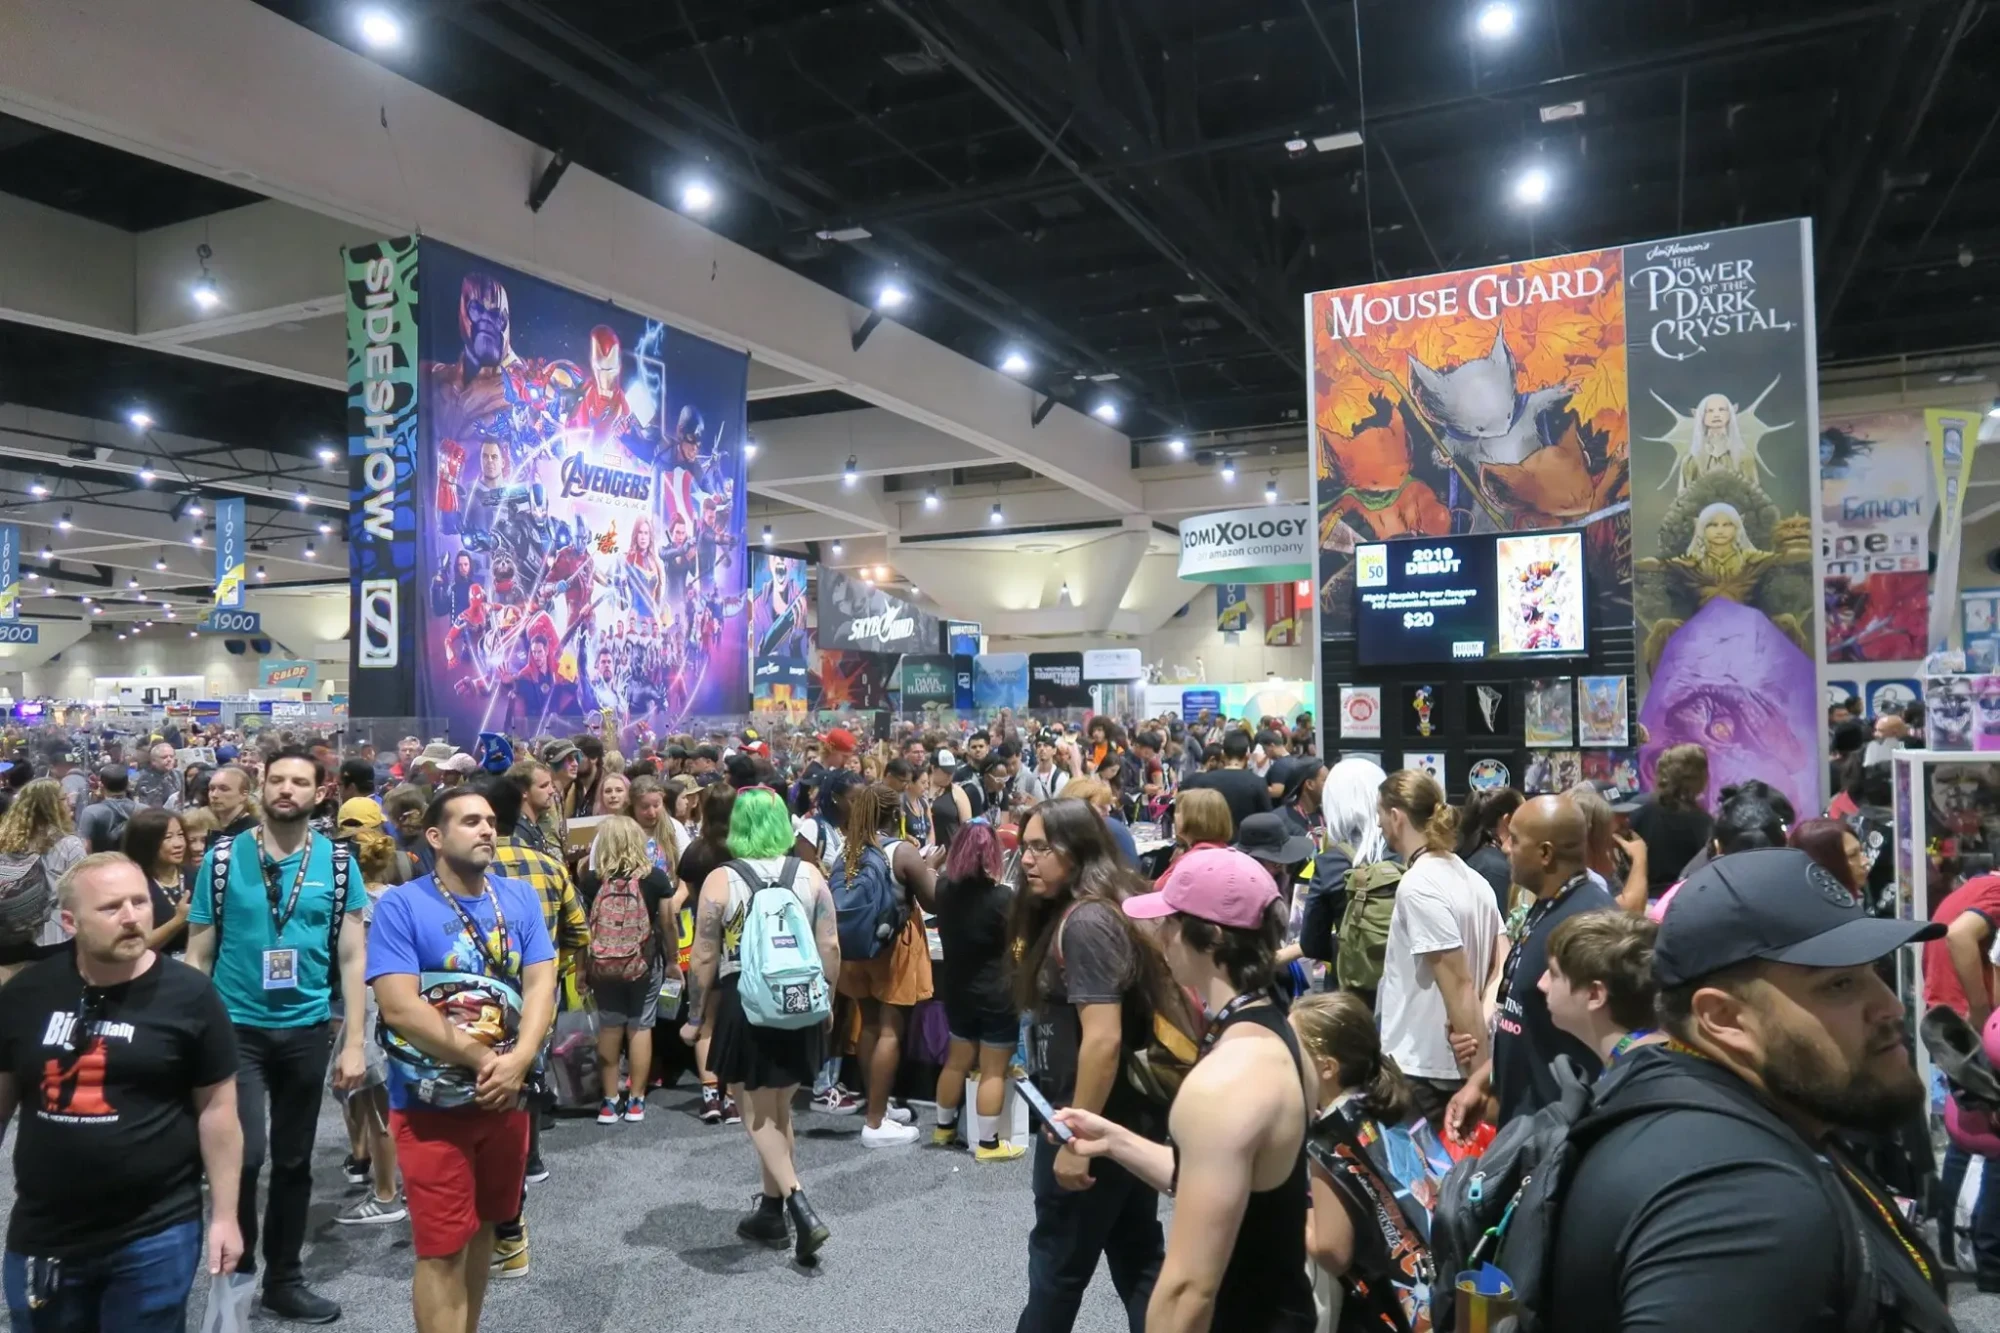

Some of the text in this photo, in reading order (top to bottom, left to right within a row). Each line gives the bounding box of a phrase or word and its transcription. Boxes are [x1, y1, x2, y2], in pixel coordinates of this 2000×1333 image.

[1669, 256, 1696, 268] THE
[1630, 259, 1757, 311] POWER
[1700, 280, 1748, 295] OF THE
[1331, 267, 1604, 340] MOUSE GUARD
[1663, 288, 1758, 320] DARK
[1651, 308, 1791, 361] CRYSTAL
[364, 257, 394, 541] SIDESHOW
[561, 451, 652, 501] AVENGERS
[587, 495, 648, 511] ENDGAME
[1842, 496, 1922, 520] FATHOM
[224, 504, 234, 571] 1900
[1209, 548, 1245, 560] amazon
[1247, 543, 1304, 556] company
[1413, 547, 1453, 562] 2019
[1368, 565, 1384, 579] 50
[1405, 559, 1461, 575] DEBUT
[214, 612, 255, 631] 1900
[848, 599, 916, 643] SKYBOUND
[1403, 611, 1434, 629] $20
[907, 684, 947, 695] HARVEST
[914, 677, 941, 689] DARK
